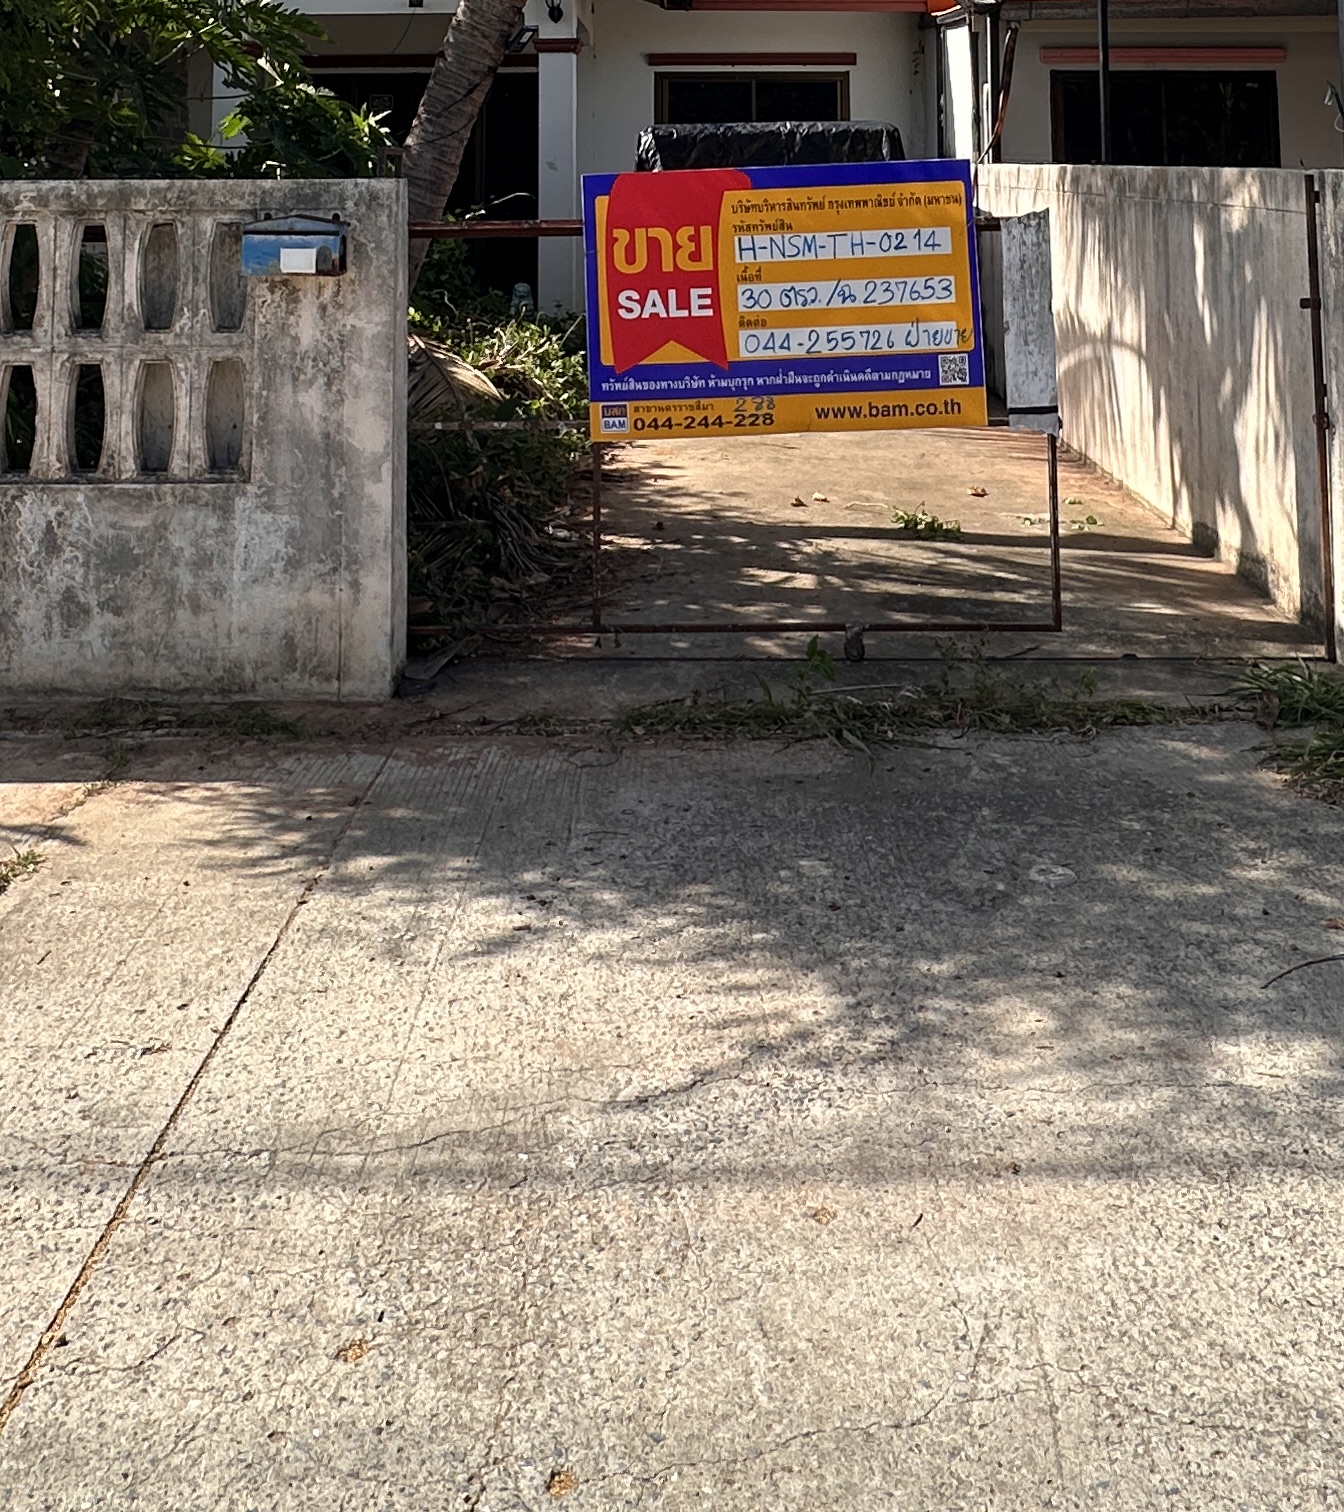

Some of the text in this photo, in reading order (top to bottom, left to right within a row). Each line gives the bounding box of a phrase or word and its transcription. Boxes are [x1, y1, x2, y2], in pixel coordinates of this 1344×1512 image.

[613, 225, 713, 274] ขาย
[736, 265, 762, 282] เนื้อที่
[617, 287, 713, 319] SALE
[741, 287, 772, 309] 30
[862, 277, 953, 305] 237653
[744, 329, 894, 354] 044-255726
[815, 399, 962, 419] www.bam.co.th
[604, 419, 626, 430] BAM
[633, 412, 774, 432] 044-244-228
